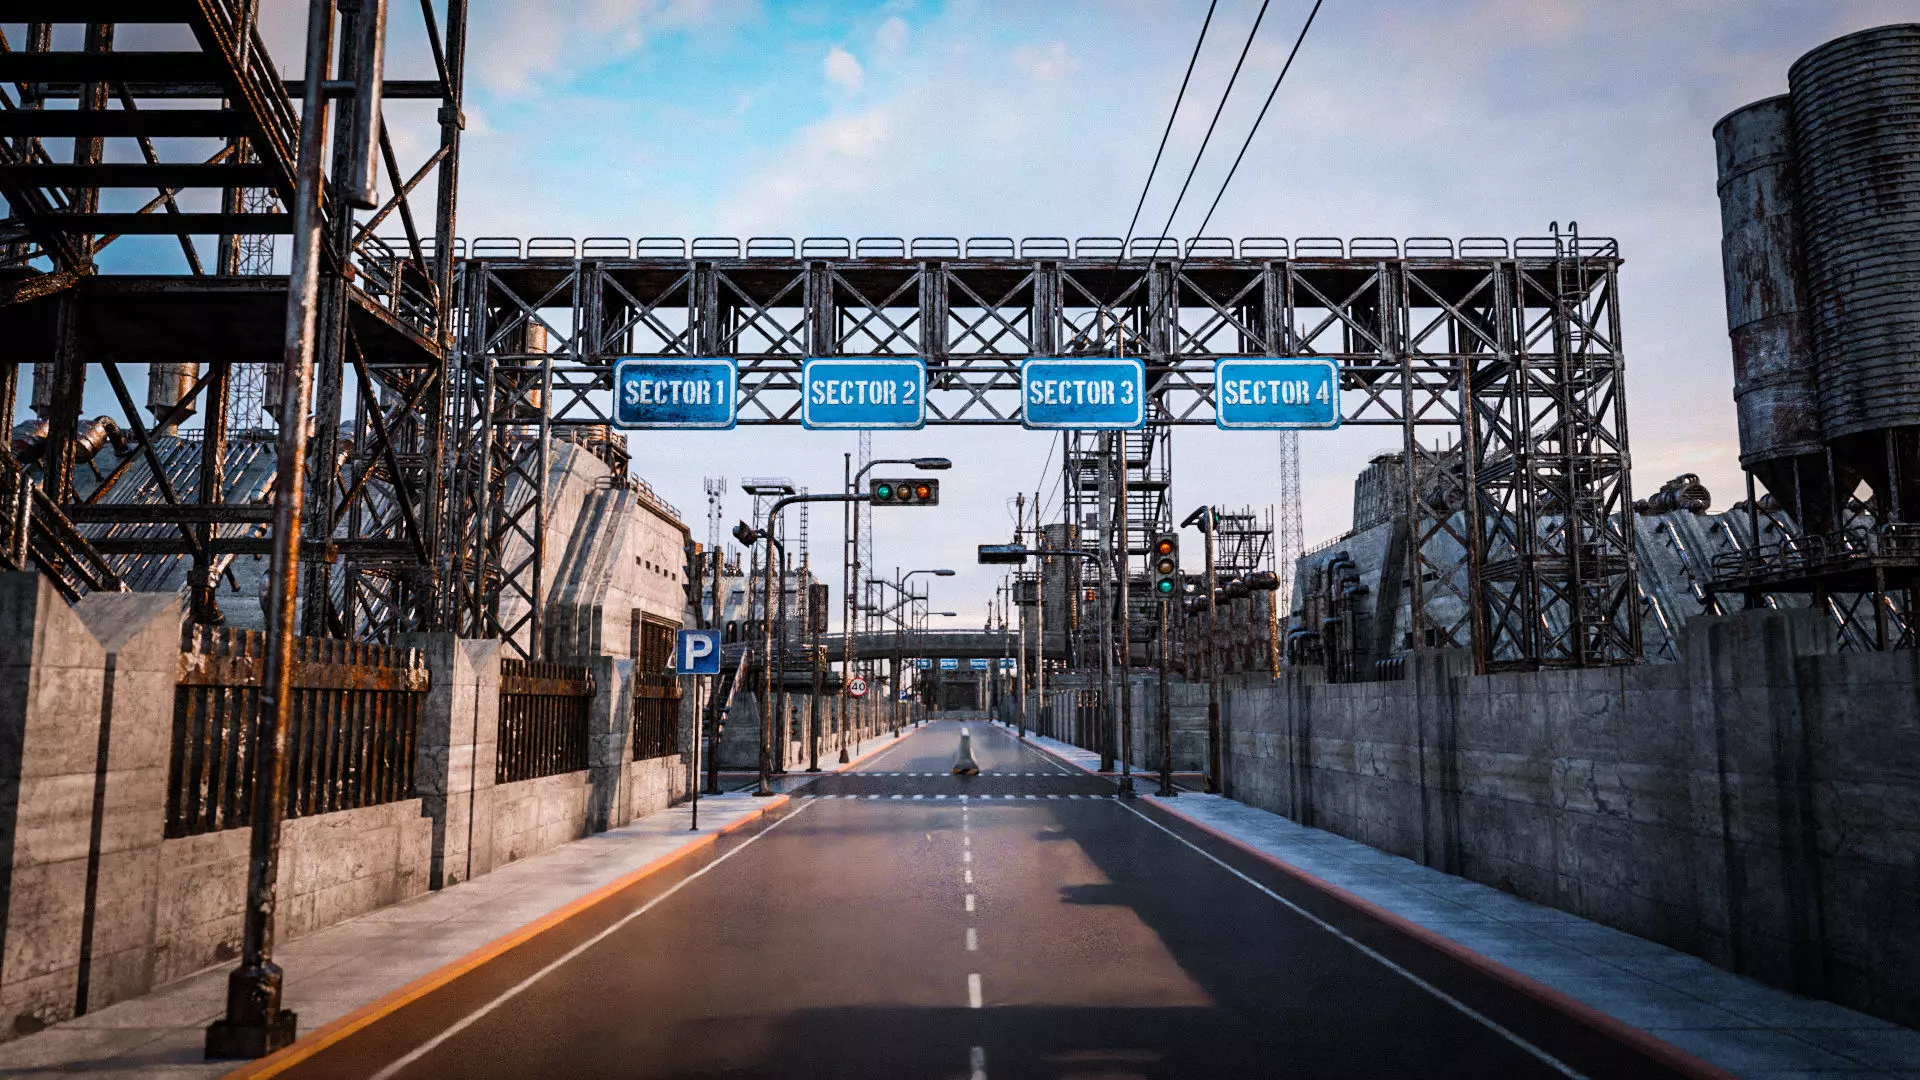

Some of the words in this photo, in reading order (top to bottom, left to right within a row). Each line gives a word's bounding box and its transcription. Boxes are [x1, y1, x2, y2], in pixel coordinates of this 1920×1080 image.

[625, 380, 711, 404] SECTOR
[717, 380, 724, 404] 1
[811, 380, 897, 404] SECTOR
[903, 380, 916, 404] 2
[1029, 380, 1115, 404] SECTOR
[1120, 380, 1134, 404] 3
[1224, 380, 1310, 404] SECTOR
[1316, 380, 1329, 404] 4
[686, 634, 712, 669] P
[851, 683, 866, 691] 40
